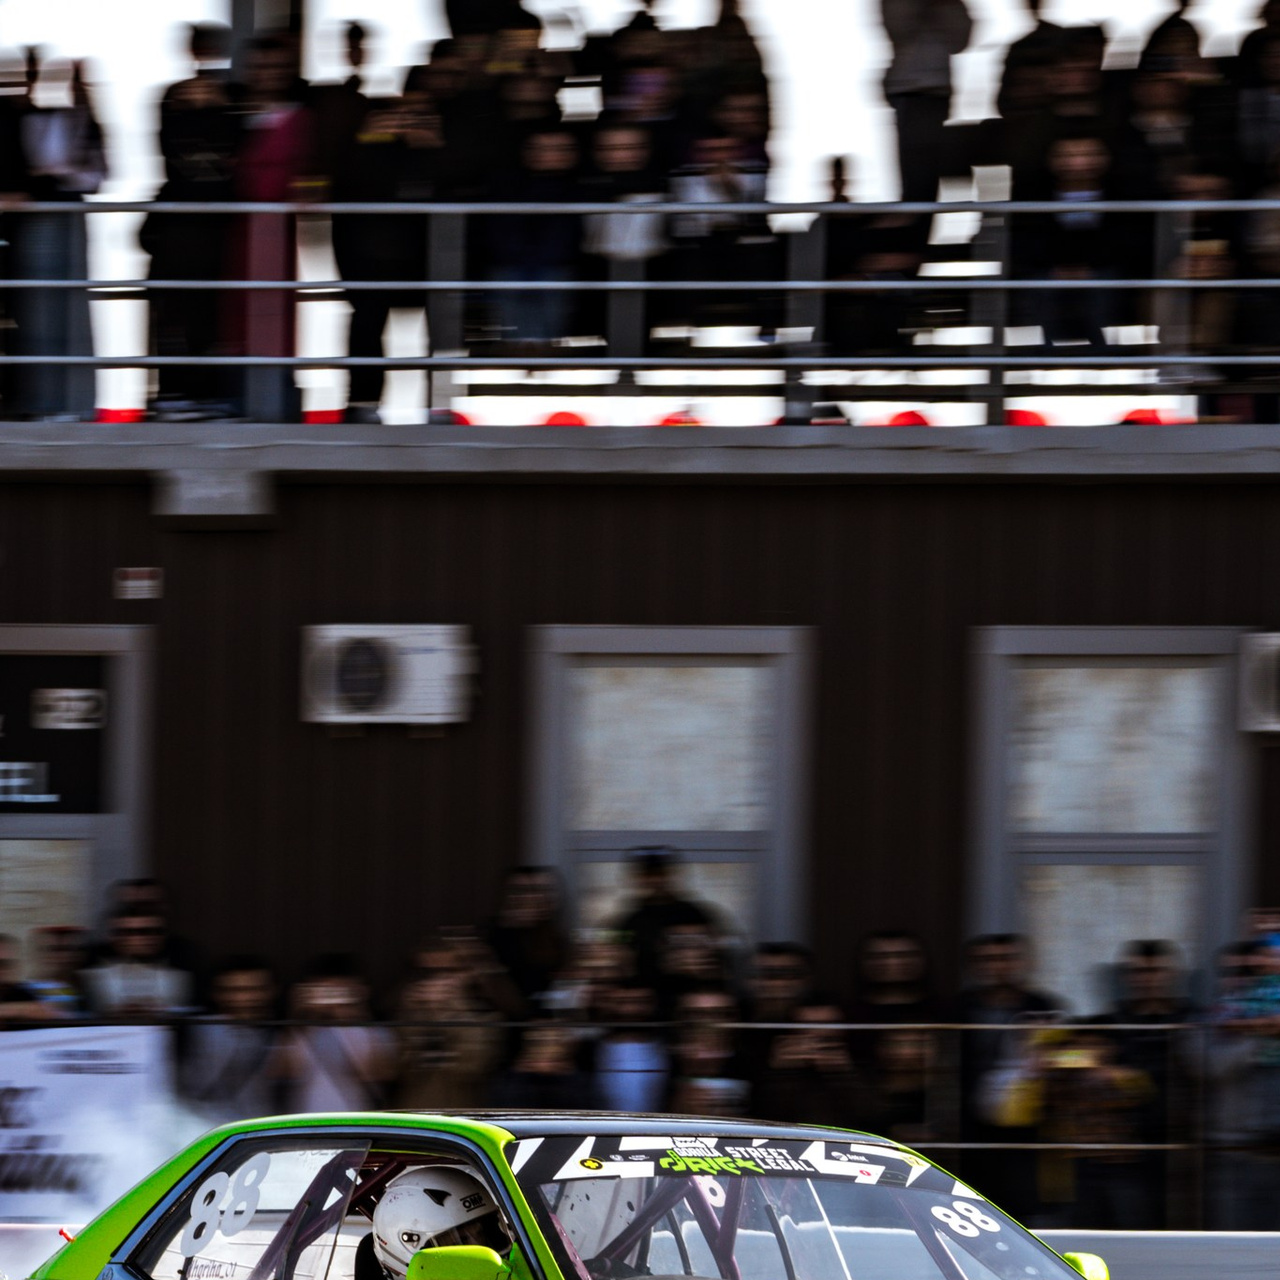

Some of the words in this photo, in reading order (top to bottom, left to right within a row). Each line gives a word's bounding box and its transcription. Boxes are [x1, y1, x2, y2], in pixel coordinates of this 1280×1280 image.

[673, 1147, 723, 1157] GORILLA
[724, 1147, 792, 1159] STREET
[755, 1158, 815, 1171] LEGAL
[180, 1151, 271, 1258] 88
[931, 1201, 1001, 1237] 88
